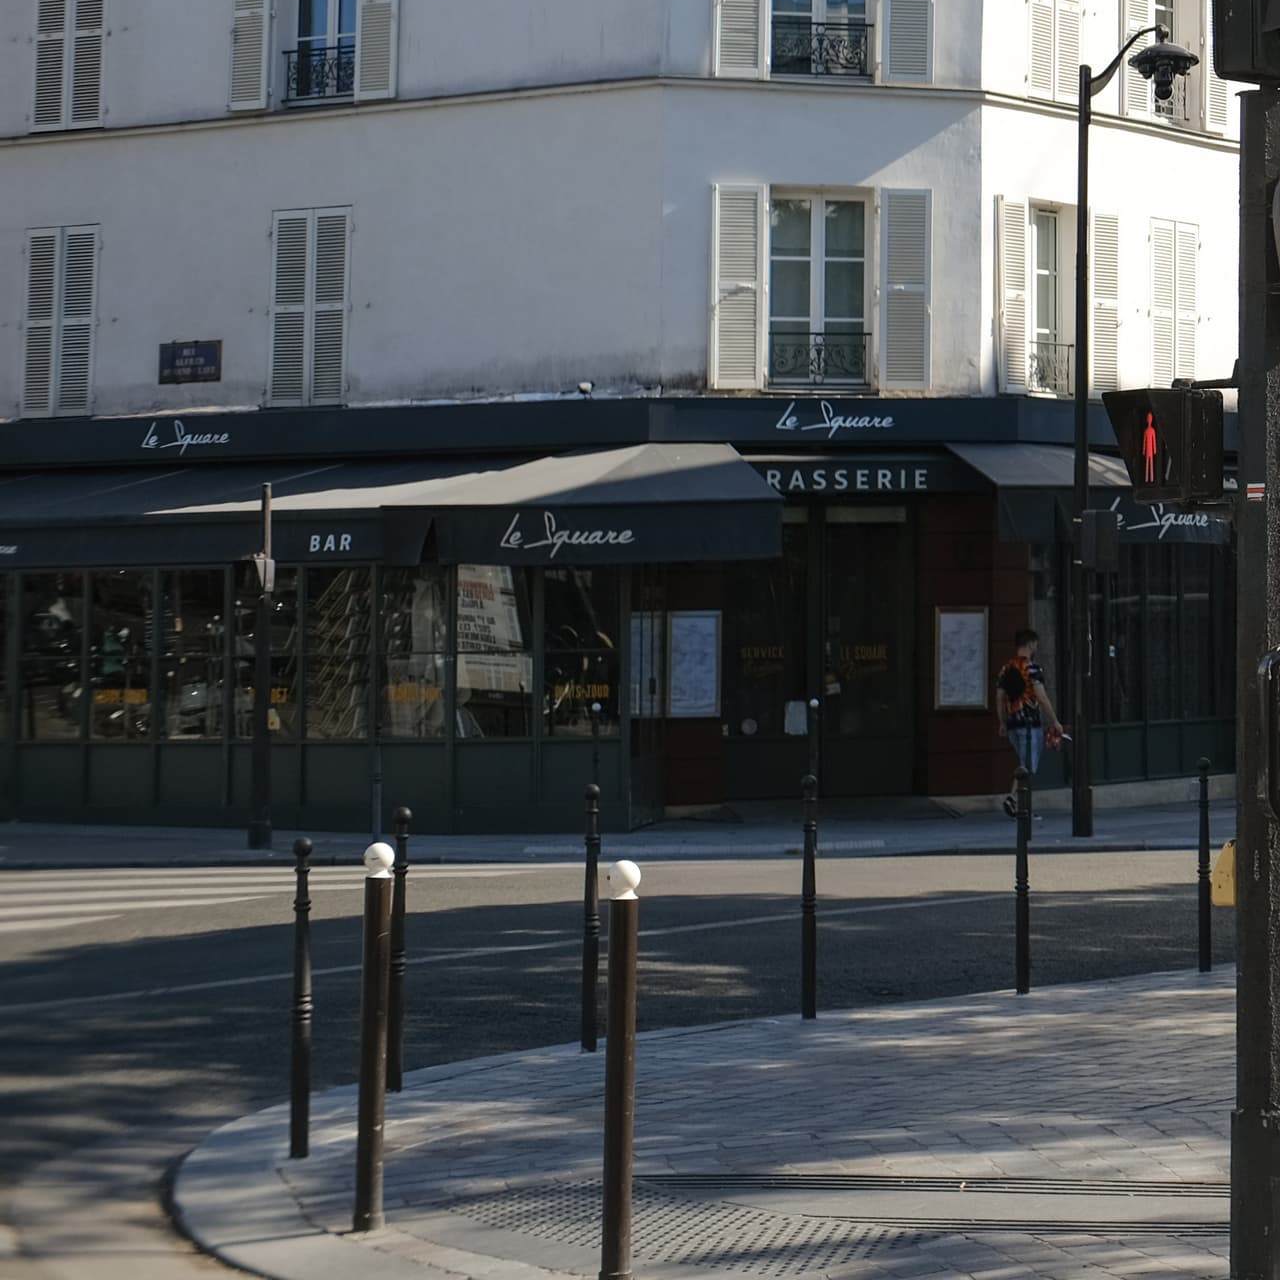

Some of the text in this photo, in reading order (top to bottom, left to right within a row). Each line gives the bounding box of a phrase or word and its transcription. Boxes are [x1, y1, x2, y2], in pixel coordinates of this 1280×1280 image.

[141, 420, 230, 455] Le Square
[776, 400, 895, 439] Le Square
[766, 468, 928, 490] RASSERIE
[499, 510, 635, 559] Le Square
[1126, 502, 1209, 540] Square
[309, 534, 352, 553] BAR
